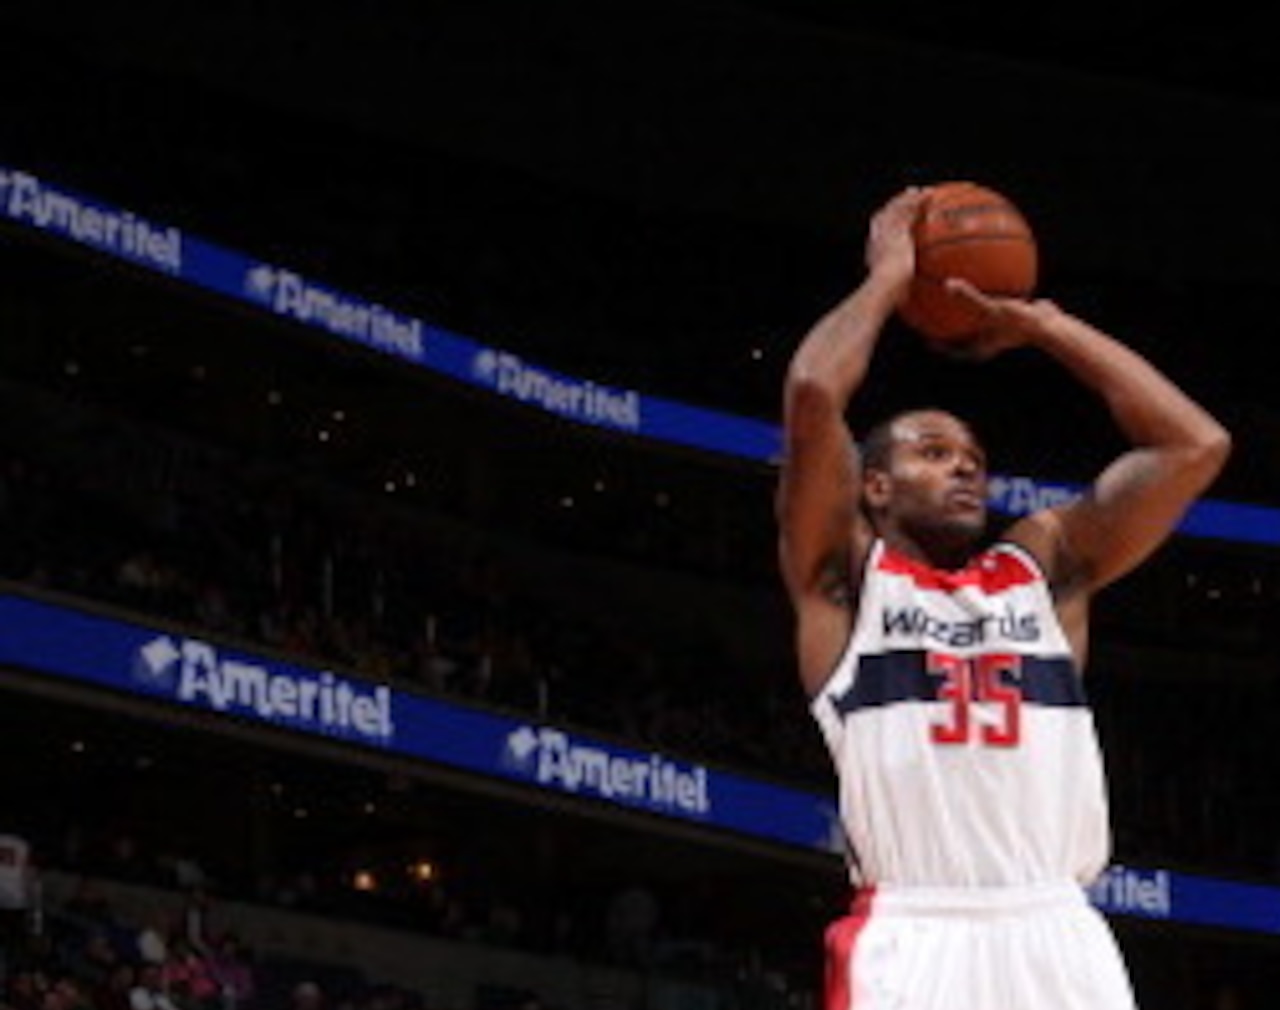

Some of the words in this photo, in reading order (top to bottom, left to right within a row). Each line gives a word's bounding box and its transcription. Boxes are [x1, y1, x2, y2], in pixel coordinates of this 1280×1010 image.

[180, 639, 393, 736] Ameritel
[925, 652, 1022, 746] 35
[538, 728, 709, 813] Ameritel
